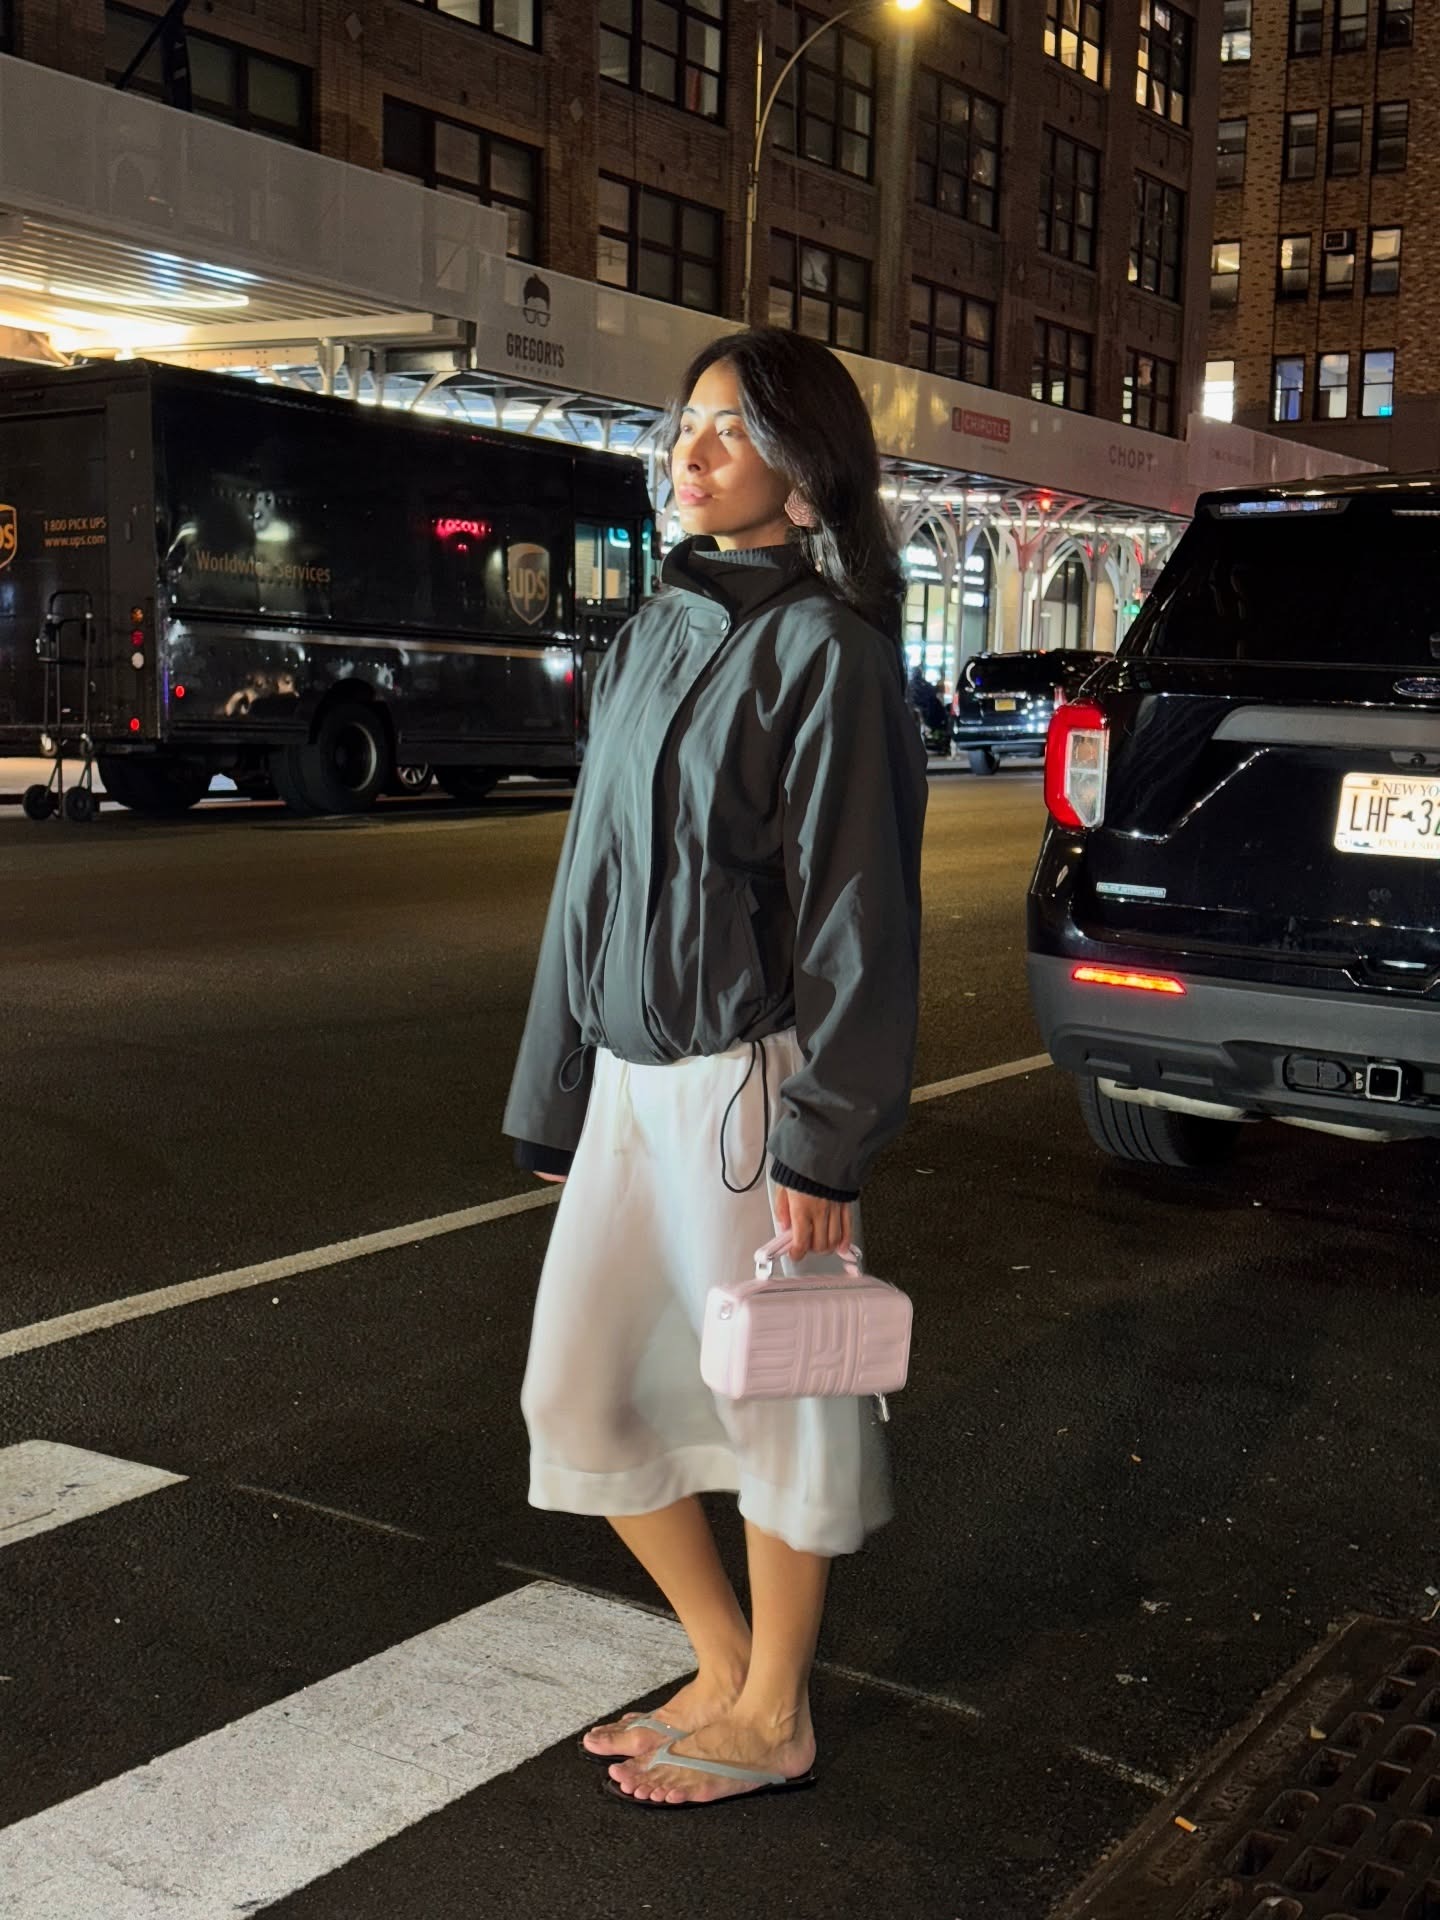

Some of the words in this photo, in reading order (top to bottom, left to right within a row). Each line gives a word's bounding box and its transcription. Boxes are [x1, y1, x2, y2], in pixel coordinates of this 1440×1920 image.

[506, 332, 565, 369] GREGORYS
[963, 413, 1009, 439] CHIPOTLE
[68, 518, 88, 531] PICK
[89, 516, 107, 529] UPS
[44, 535, 107, 549] www.ups.com
[277, 560, 331, 583] Services
[512, 567, 547, 611] ups
[1382, 783, 1417, 795] NEW
[1420, 784, 1440, 796] YO
